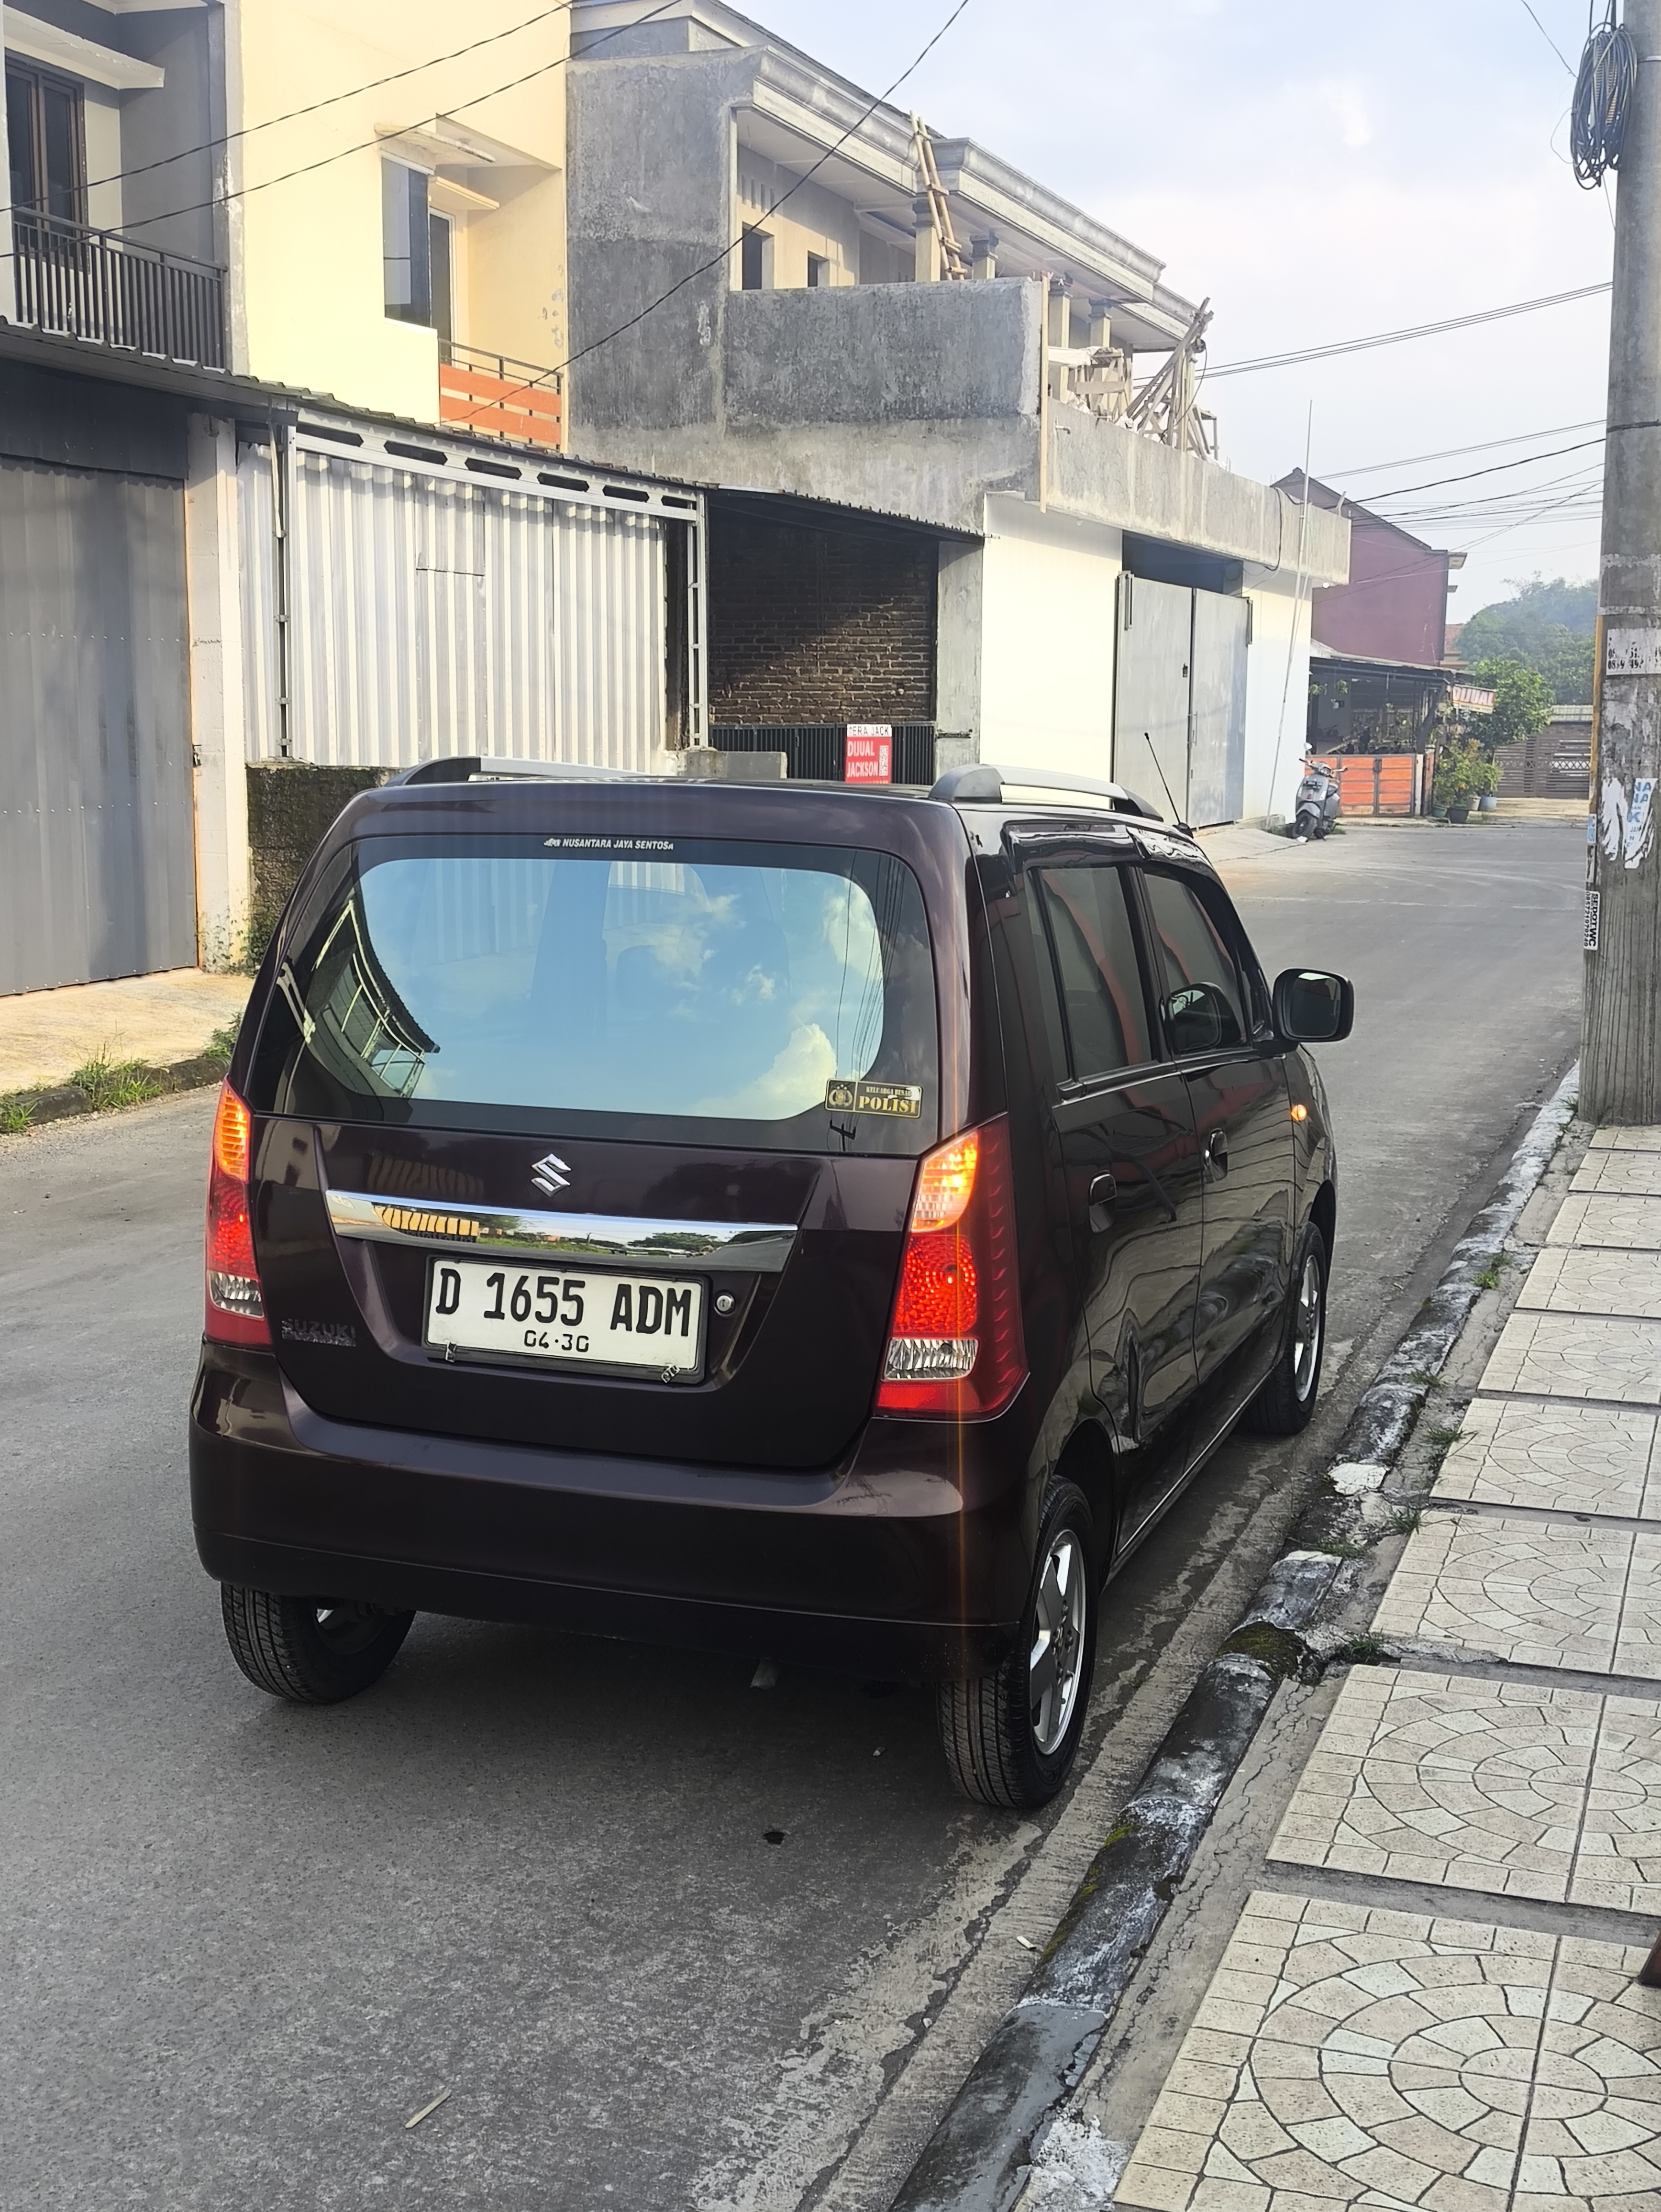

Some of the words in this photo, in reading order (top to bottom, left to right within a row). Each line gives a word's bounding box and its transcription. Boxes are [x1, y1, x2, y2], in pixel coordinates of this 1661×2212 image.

[1452, 686, 1494, 707] DIJUAL
[871, 726, 889, 736] JACK
[847, 741, 875, 757] DIJUAL
[846, 761, 879, 777] JACKSON
[562, 839, 611, 848] NUSANTARA
[613, 840, 633, 849] JAYA
[635, 840, 674, 850] SENTOSA
[858, 1095, 917, 1114] POLISI
[435, 1268, 461, 1315] D
[483, 1272, 586, 1327] 1655
[610, 1283, 692, 1337] ADM
